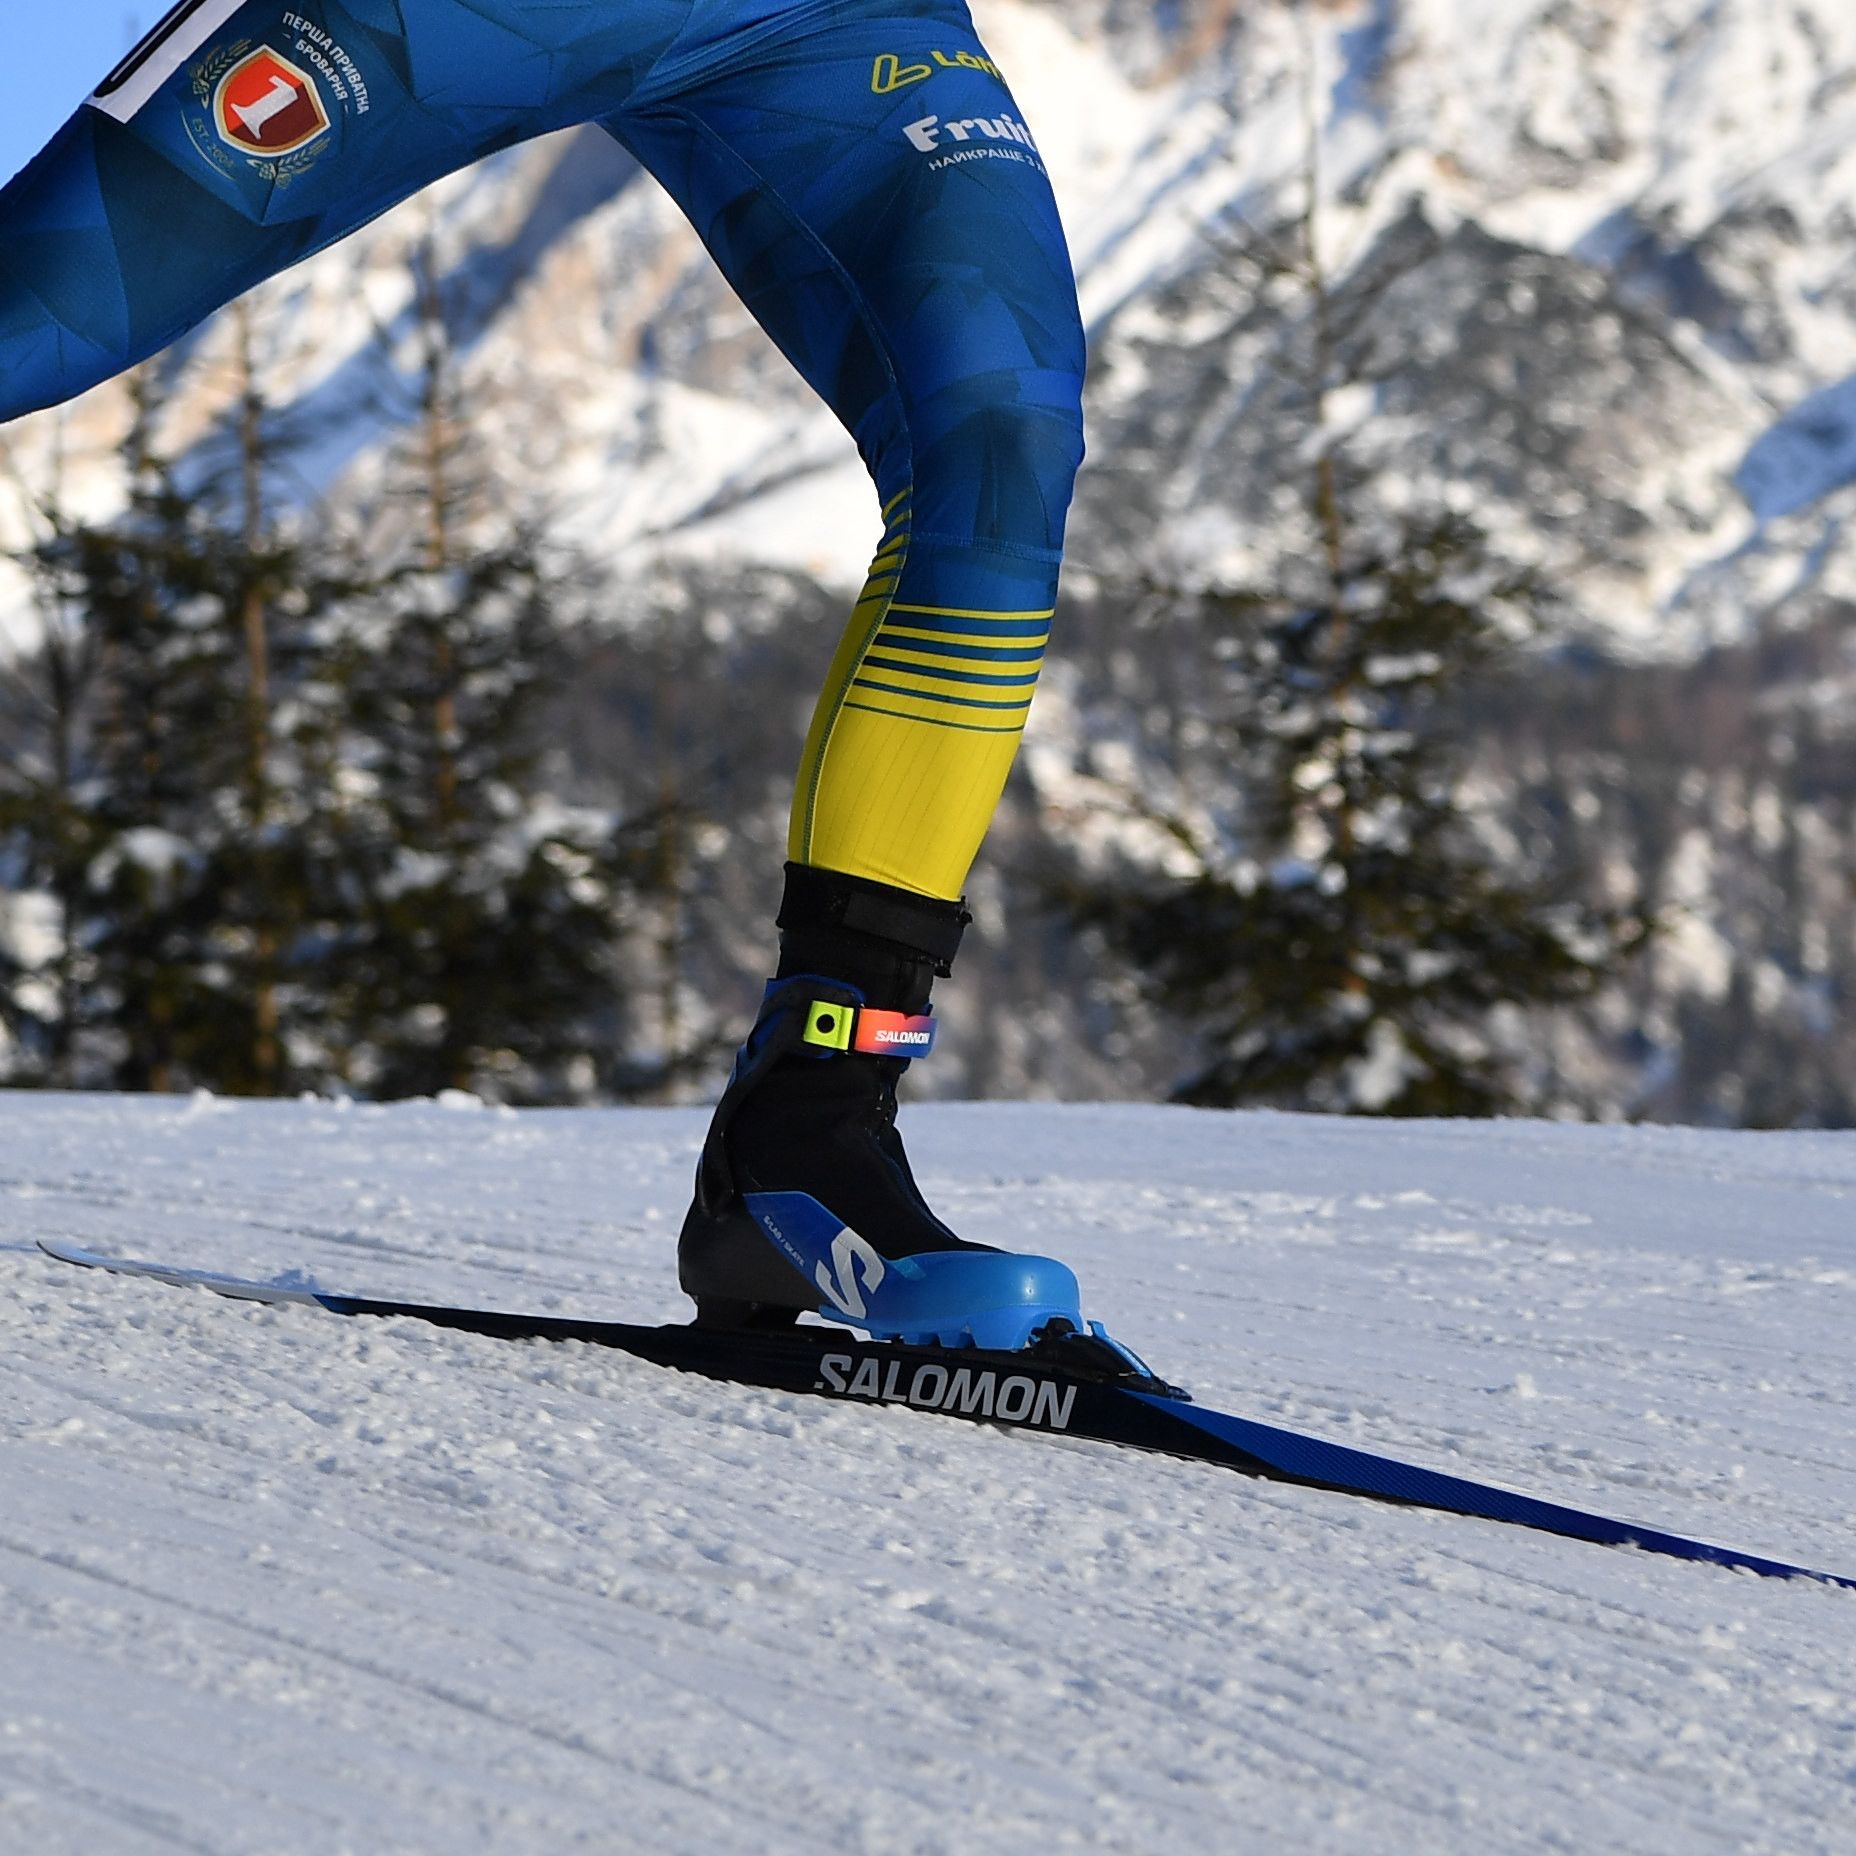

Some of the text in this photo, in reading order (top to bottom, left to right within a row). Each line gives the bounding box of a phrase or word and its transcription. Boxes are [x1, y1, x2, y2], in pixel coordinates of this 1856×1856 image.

[282, 11, 370, 116] ПЕРША ПРИВАТНА
[295, 37, 349, 101] БРОВАРНЯ
[230, 74, 299, 140] 1
[874, 1029, 931, 1045] SALOMON
[815, 1352, 1077, 1431] SALOMON
